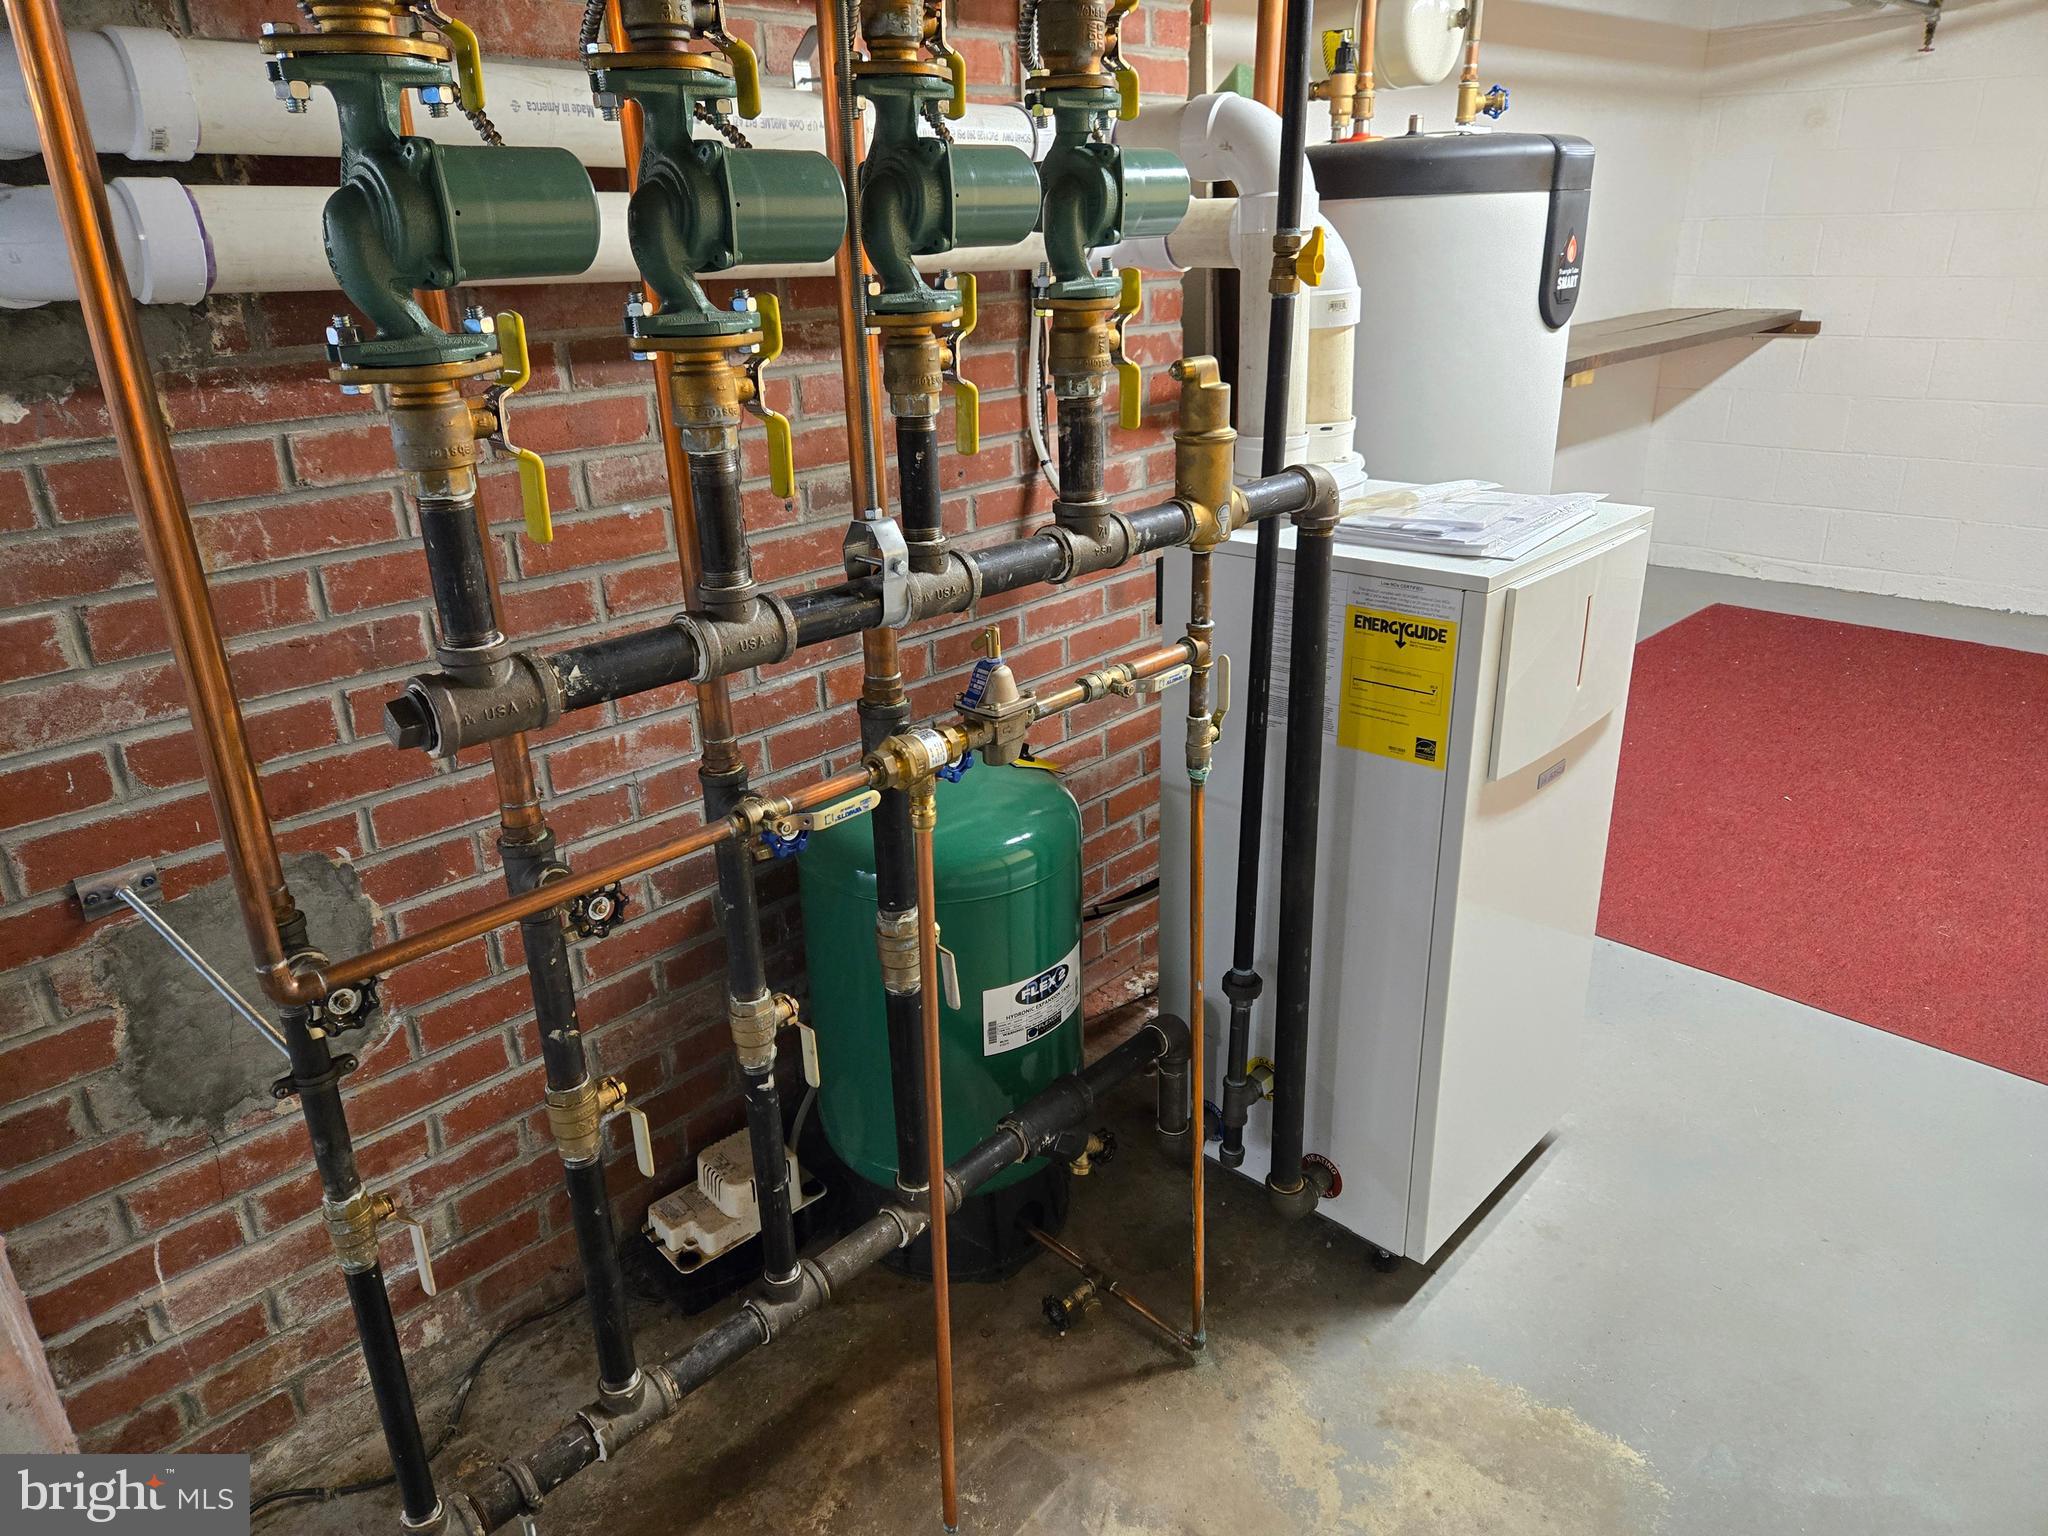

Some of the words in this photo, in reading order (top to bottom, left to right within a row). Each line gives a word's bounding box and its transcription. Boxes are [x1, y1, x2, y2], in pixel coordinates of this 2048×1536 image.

[527, 100, 562, 115] America
[562, 103, 571, 114] in
[571, 103, 595, 118] Made
[1557, 274, 1579, 290] SMART
[933, 584, 958, 602] USA
[1354, 614, 1448, 645] ENERGYGUIDE
[739, 630, 768, 653] USA
[483, 701, 520, 723] USA
[1021, 976, 1057, 1001] FLEX
[1058, 967, 1067, 982] 2
[1005, 1005, 1034, 1021] HYDRONIC
[1035, 990, 1061, 1010] EXPANSION
[1306, 1153, 1338, 1175] HEATING
